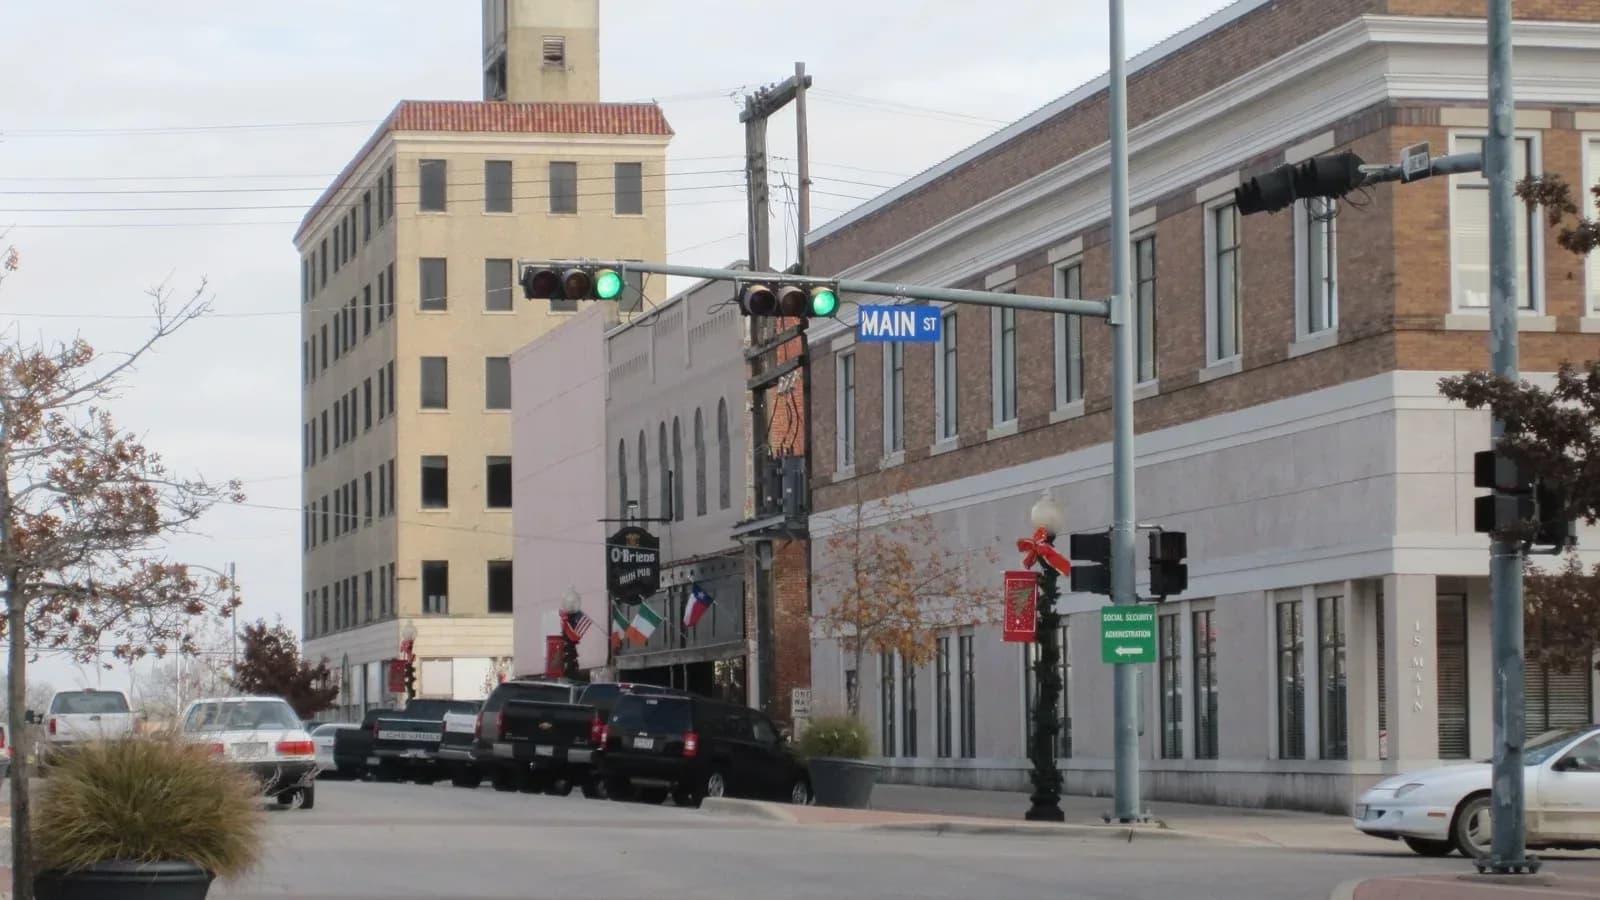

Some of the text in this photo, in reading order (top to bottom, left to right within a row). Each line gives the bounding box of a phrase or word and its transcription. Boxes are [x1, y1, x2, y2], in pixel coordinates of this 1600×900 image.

[862, 311, 937, 339] MAIN ST
[611, 548, 655, 563] O'Briens
[637, 567, 651, 577] PUB
[1103, 613, 1152, 622] SOCIAL SECURITY
[1105, 630, 1151, 638] ADMINISTRATION
